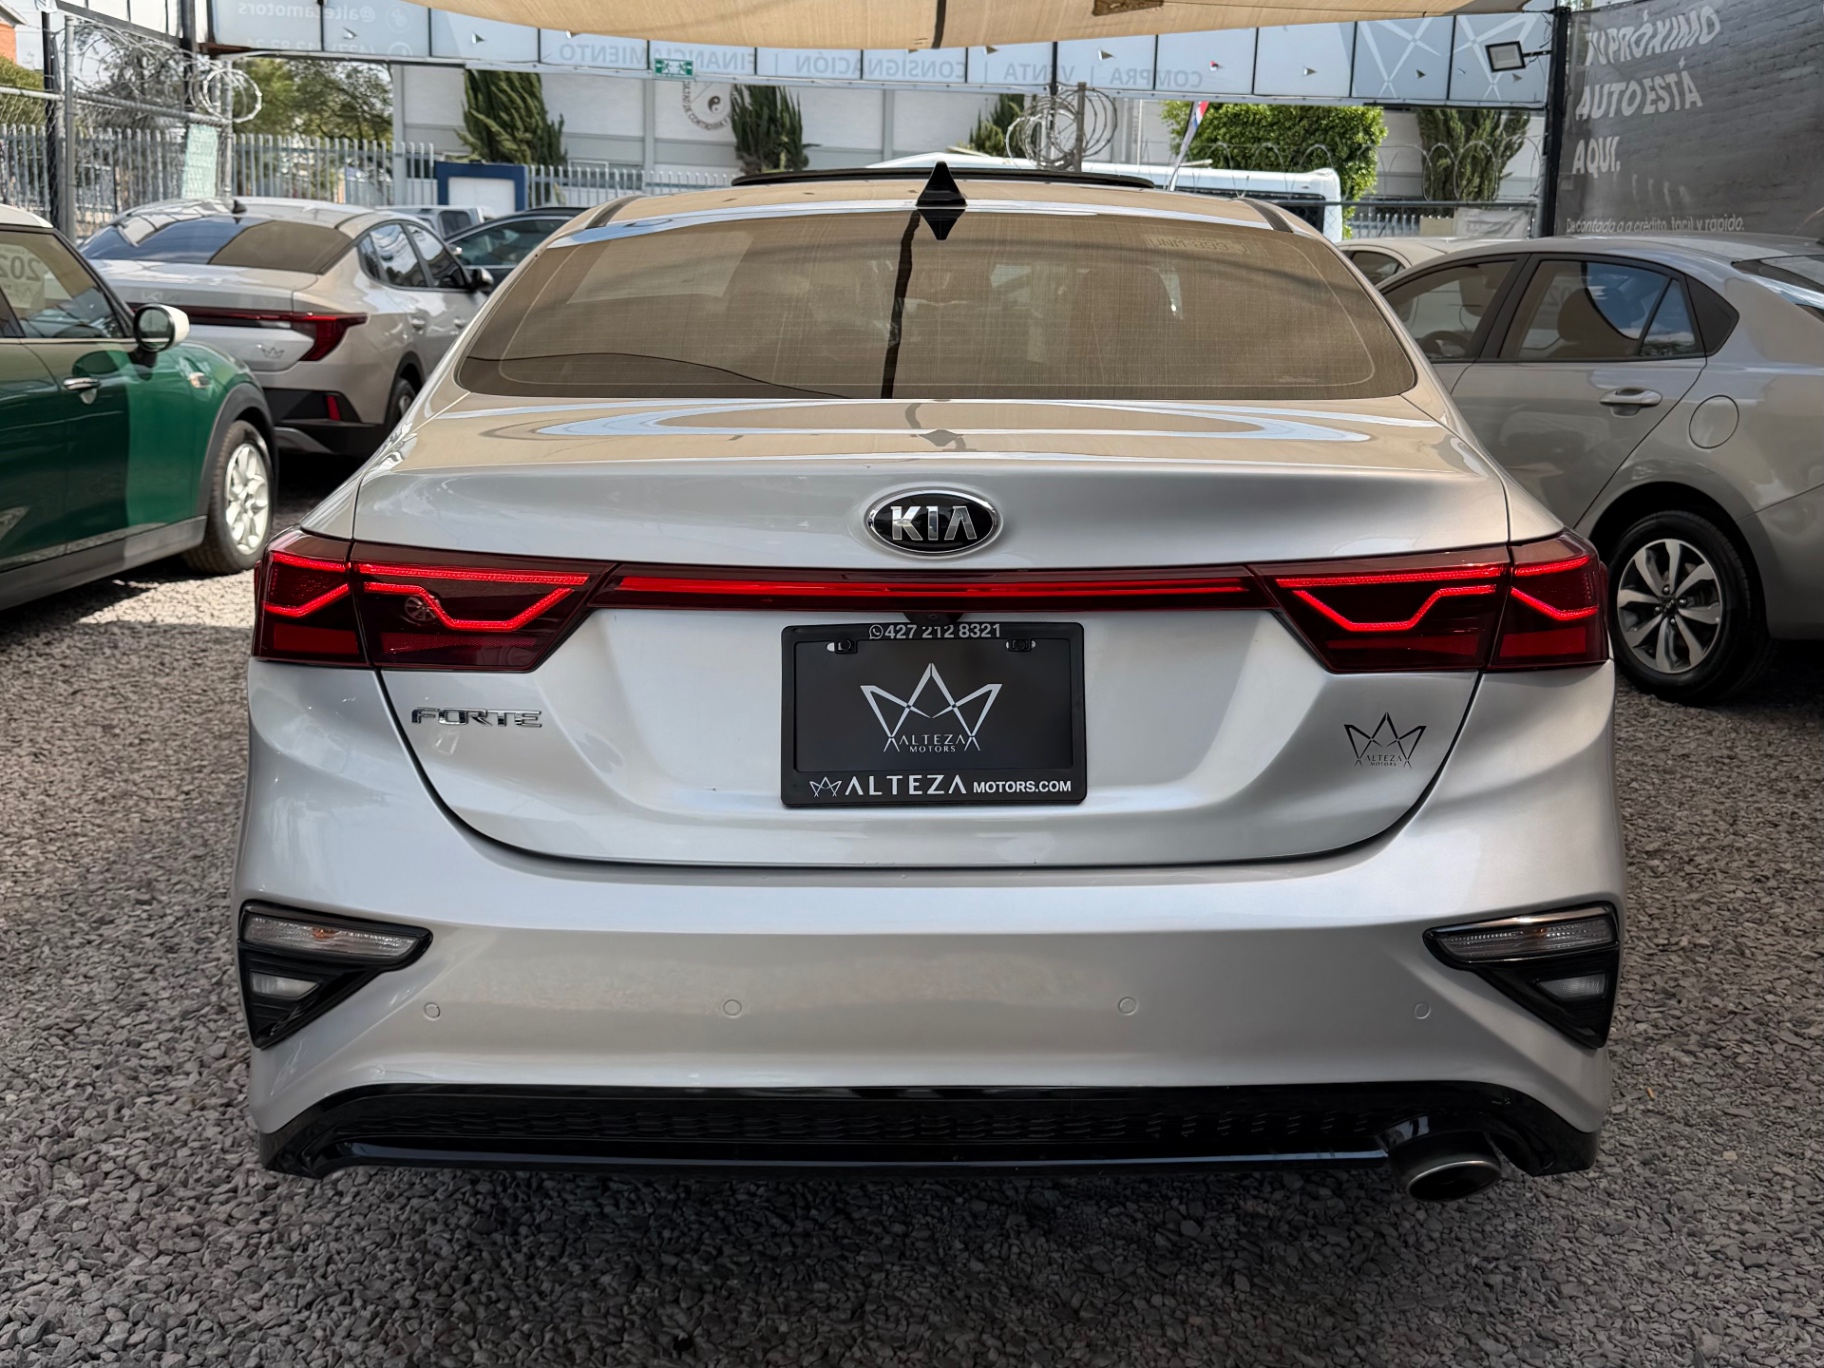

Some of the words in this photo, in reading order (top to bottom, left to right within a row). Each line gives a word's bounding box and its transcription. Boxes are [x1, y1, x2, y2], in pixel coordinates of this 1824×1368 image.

[1607, 5, 1721, 63] PRÓXIMO
[1575, 80, 1642, 121] AUTO
[1642, 56, 1703, 115] ESTÁ
[1575, 217, 1615, 233] contado
[890, 506, 978, 541] KIA
[884, 624, 917, 639] 427
[922, 624, 954, 638] 212
[958, 623, 1000, 638] 8321
[411, 707, 542, 728] FORTE
[899, 734, 965, 745] ALTEZA
[909, 745, 956, 753] MOTORS
[845, 774, 967, 795] ALTEZA
[973, 780, 1072, 793] MOTORS.COM
